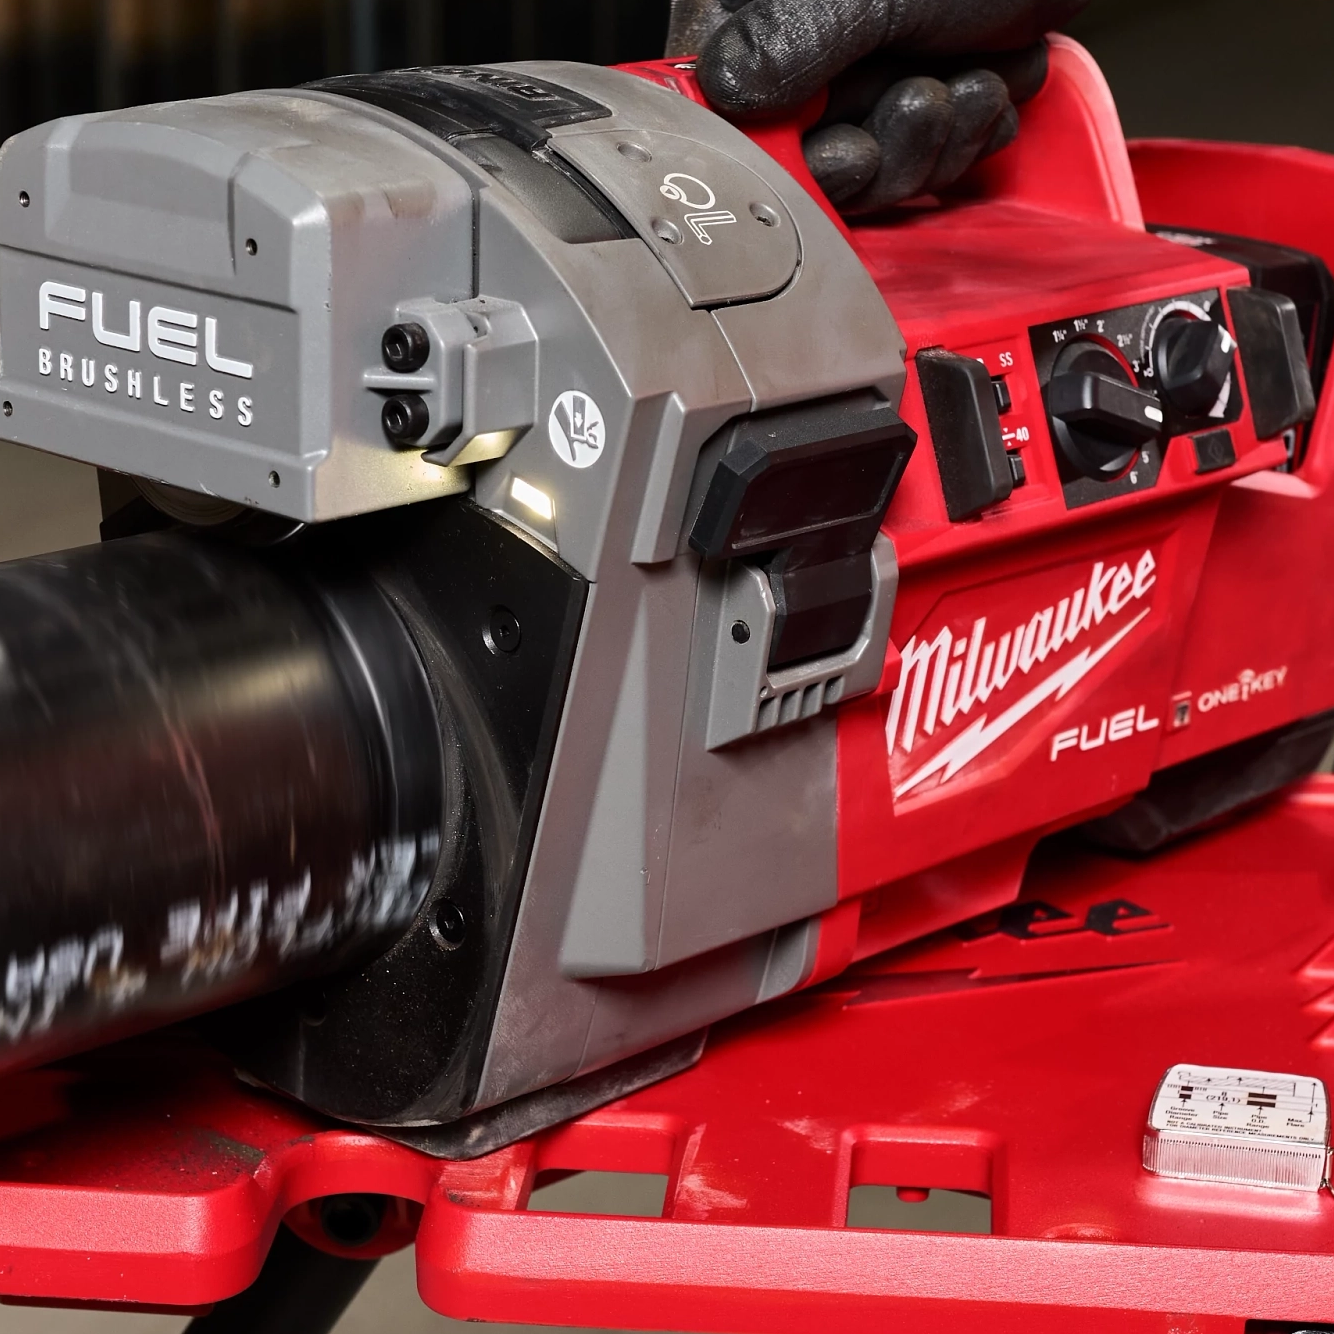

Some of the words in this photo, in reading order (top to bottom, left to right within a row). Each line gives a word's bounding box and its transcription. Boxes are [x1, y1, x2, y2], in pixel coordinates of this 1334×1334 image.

[38, 280, 254, 379] FUEL
[998, 351, 1014, 368] SS
[38, 347, 254, 428] BRUSHLESS
[1016, 426, 1030, 442] 40
[885, 548, 1157, 757] Milwaukee
[1049, 704, 1161, 762] FUEL
